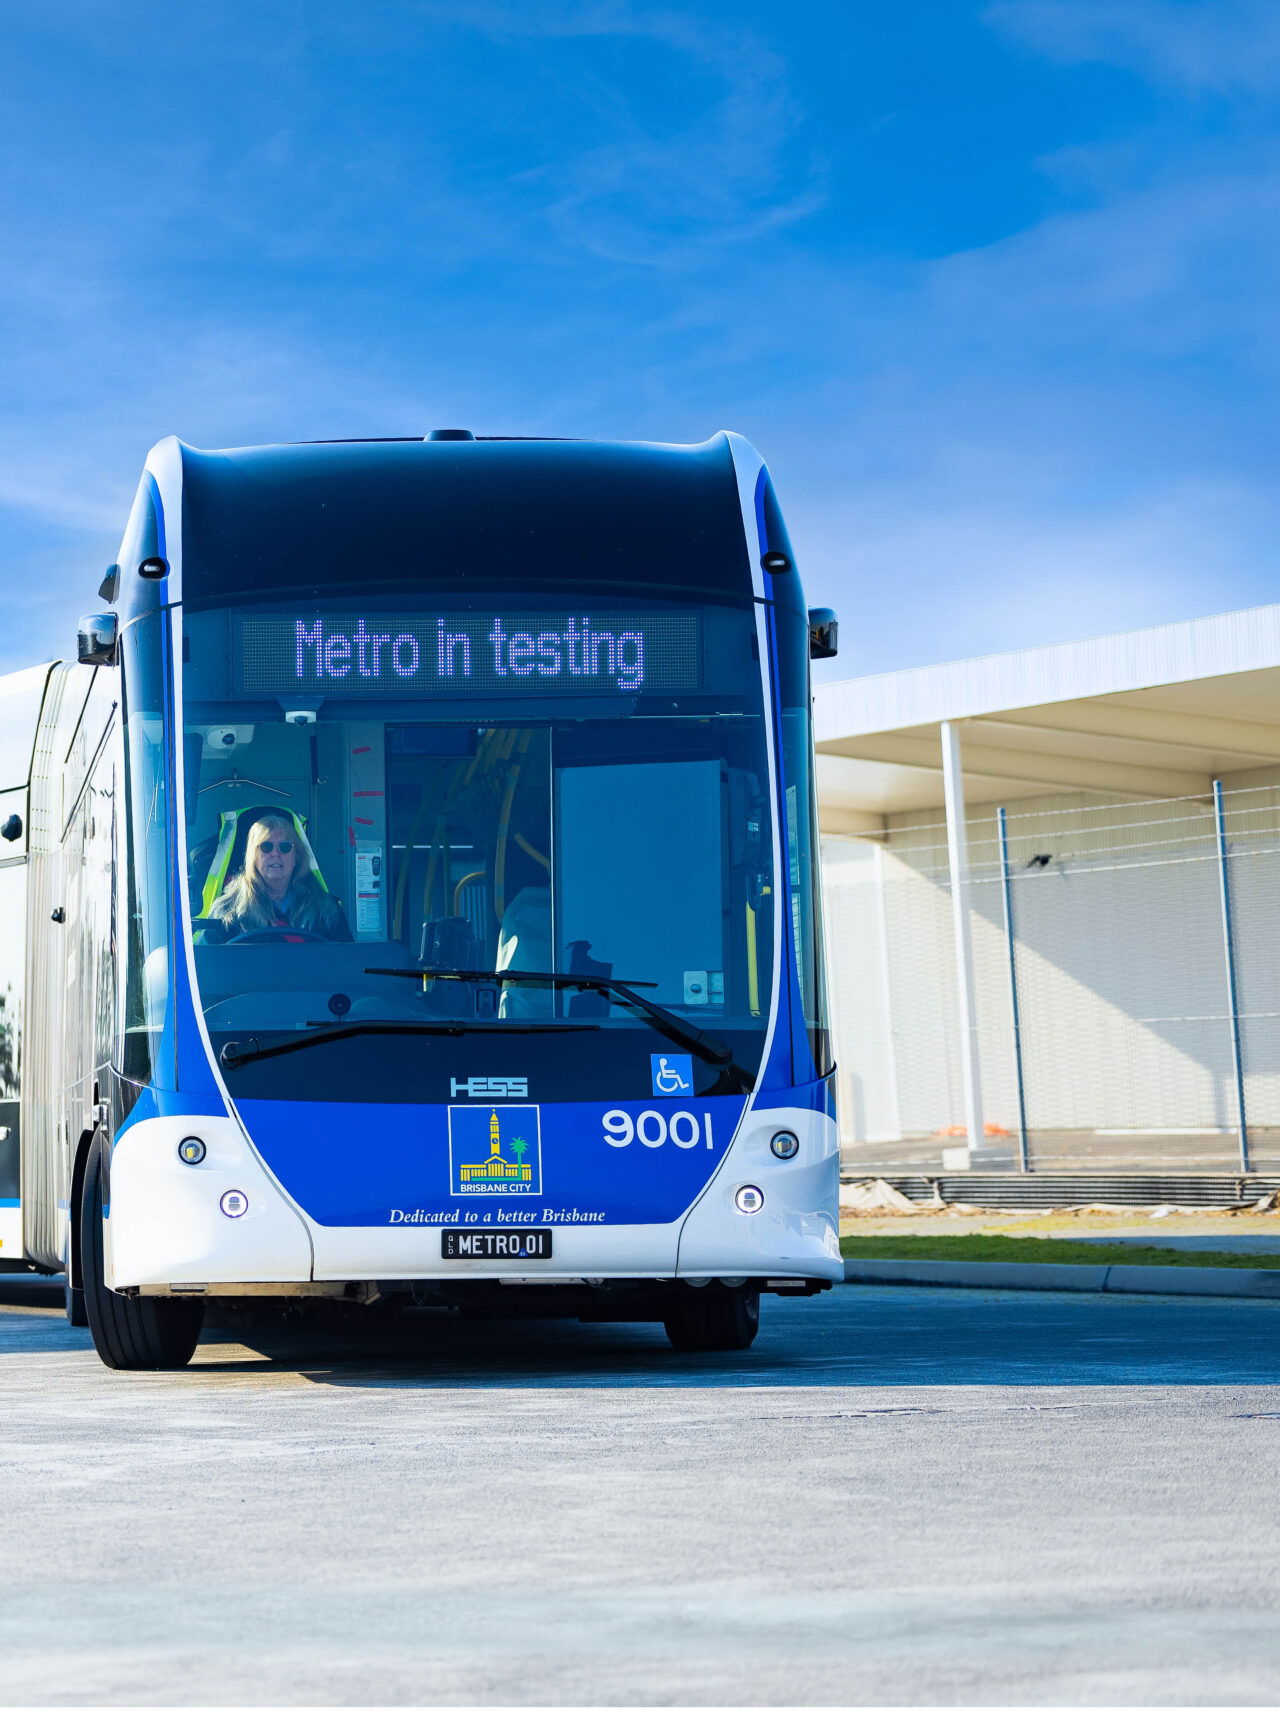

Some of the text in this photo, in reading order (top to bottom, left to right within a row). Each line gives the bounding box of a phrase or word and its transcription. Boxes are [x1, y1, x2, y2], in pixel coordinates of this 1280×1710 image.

[295, 618, 643, 689] Metro in testing
[450, 1077, 528, 1097] HESS
[601, 1110, 714, 1149] 9001
[460, 1183, 532, 1192] BRISBANE CITY
[389, 1208, 606, 1223] Dedicated to a better Brisbane
[458, 1235, 520, 1254] METRO
